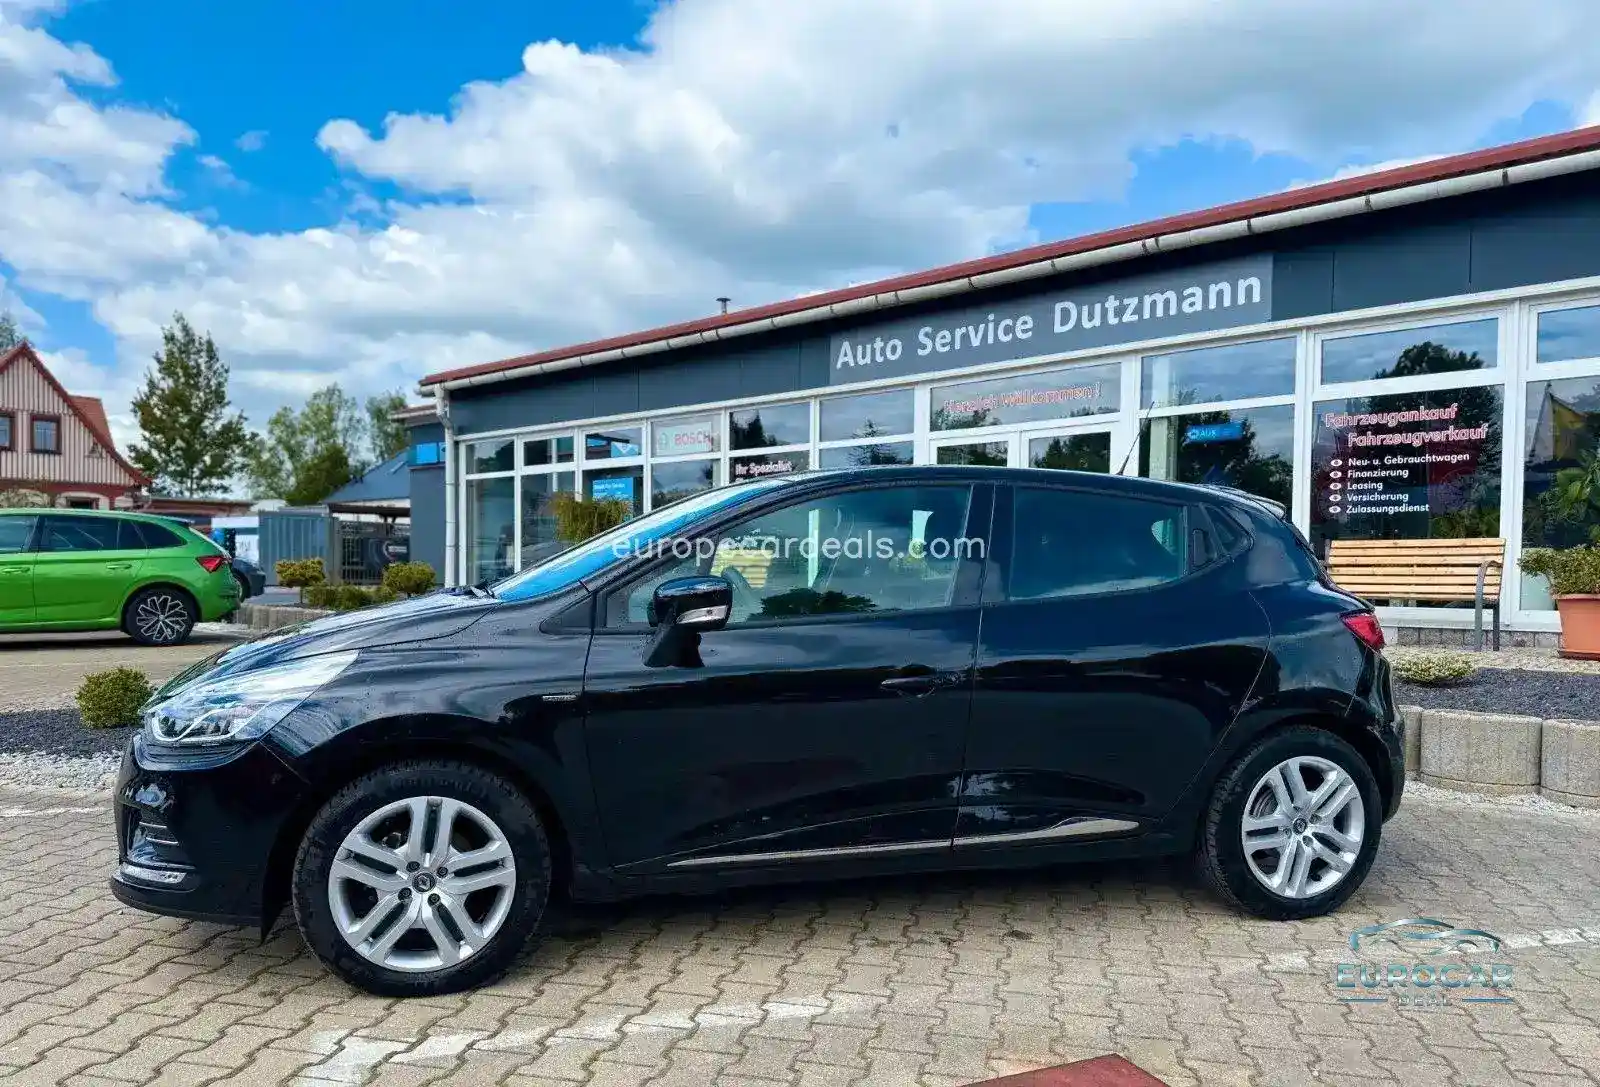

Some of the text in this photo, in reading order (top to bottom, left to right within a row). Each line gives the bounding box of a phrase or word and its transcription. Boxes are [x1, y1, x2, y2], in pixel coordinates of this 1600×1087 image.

[836, 275, 1262, 370] Auto Service Dutzmann
[1325, 403, 1458, 427] Fahrzeugankauf
[675, 430, 713, 446] BOSCH
[1347, 423, 1489, 447] Fahrzeugverkauf
[1348, 457, 1370, 467] Neu-
[1384, 452, 1470, 466] Gebrauchtwagen
[735, 461, 792, 476] Ihr Spezialist
[1347, 468, 1409, 479] Finanzierung
[1347, 481, 1383, 491] Leasing
[1346, 492, 1409, 503] Versicherung
[1346, 503, 1430, 515] Zulassungsdienst
